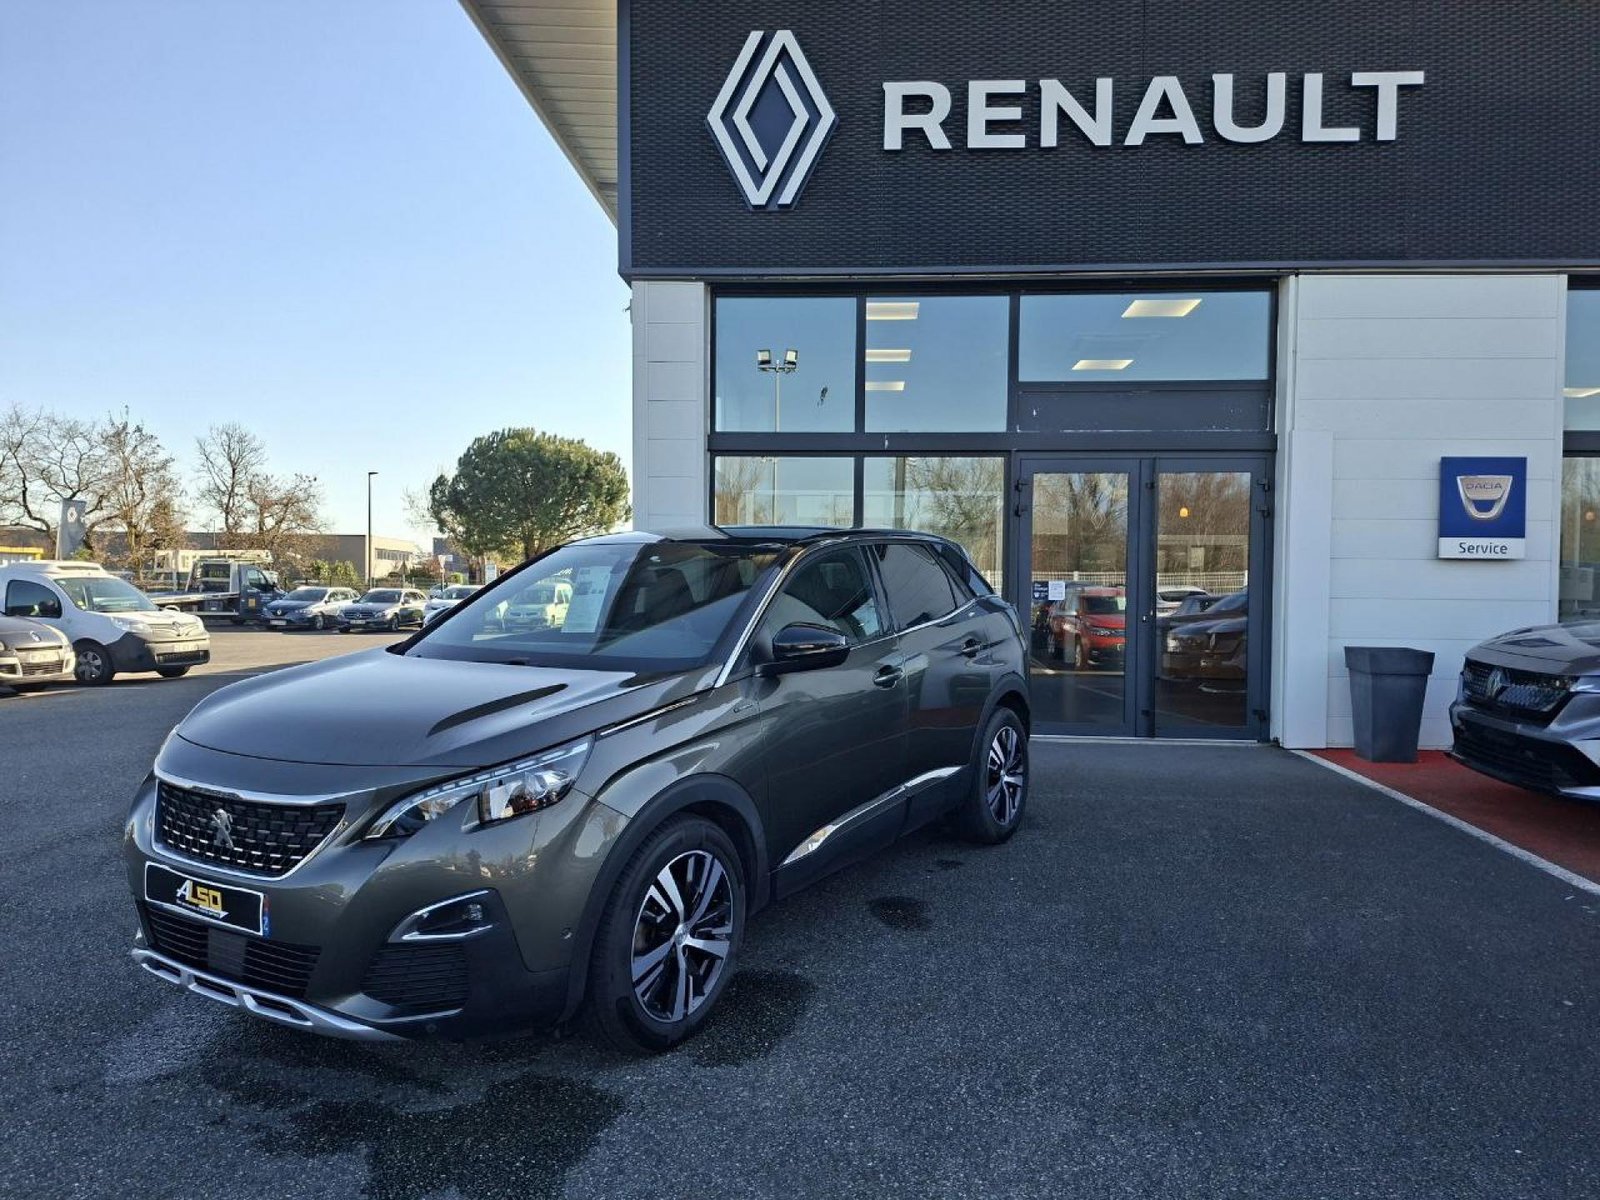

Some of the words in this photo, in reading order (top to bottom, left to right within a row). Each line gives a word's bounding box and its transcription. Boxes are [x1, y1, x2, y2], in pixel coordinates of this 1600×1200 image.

[882, 71, 1425, 151] RENAULT
[1465, 482, 1503, 491] DACIA
[1458, 541, 1509, 555] Service
